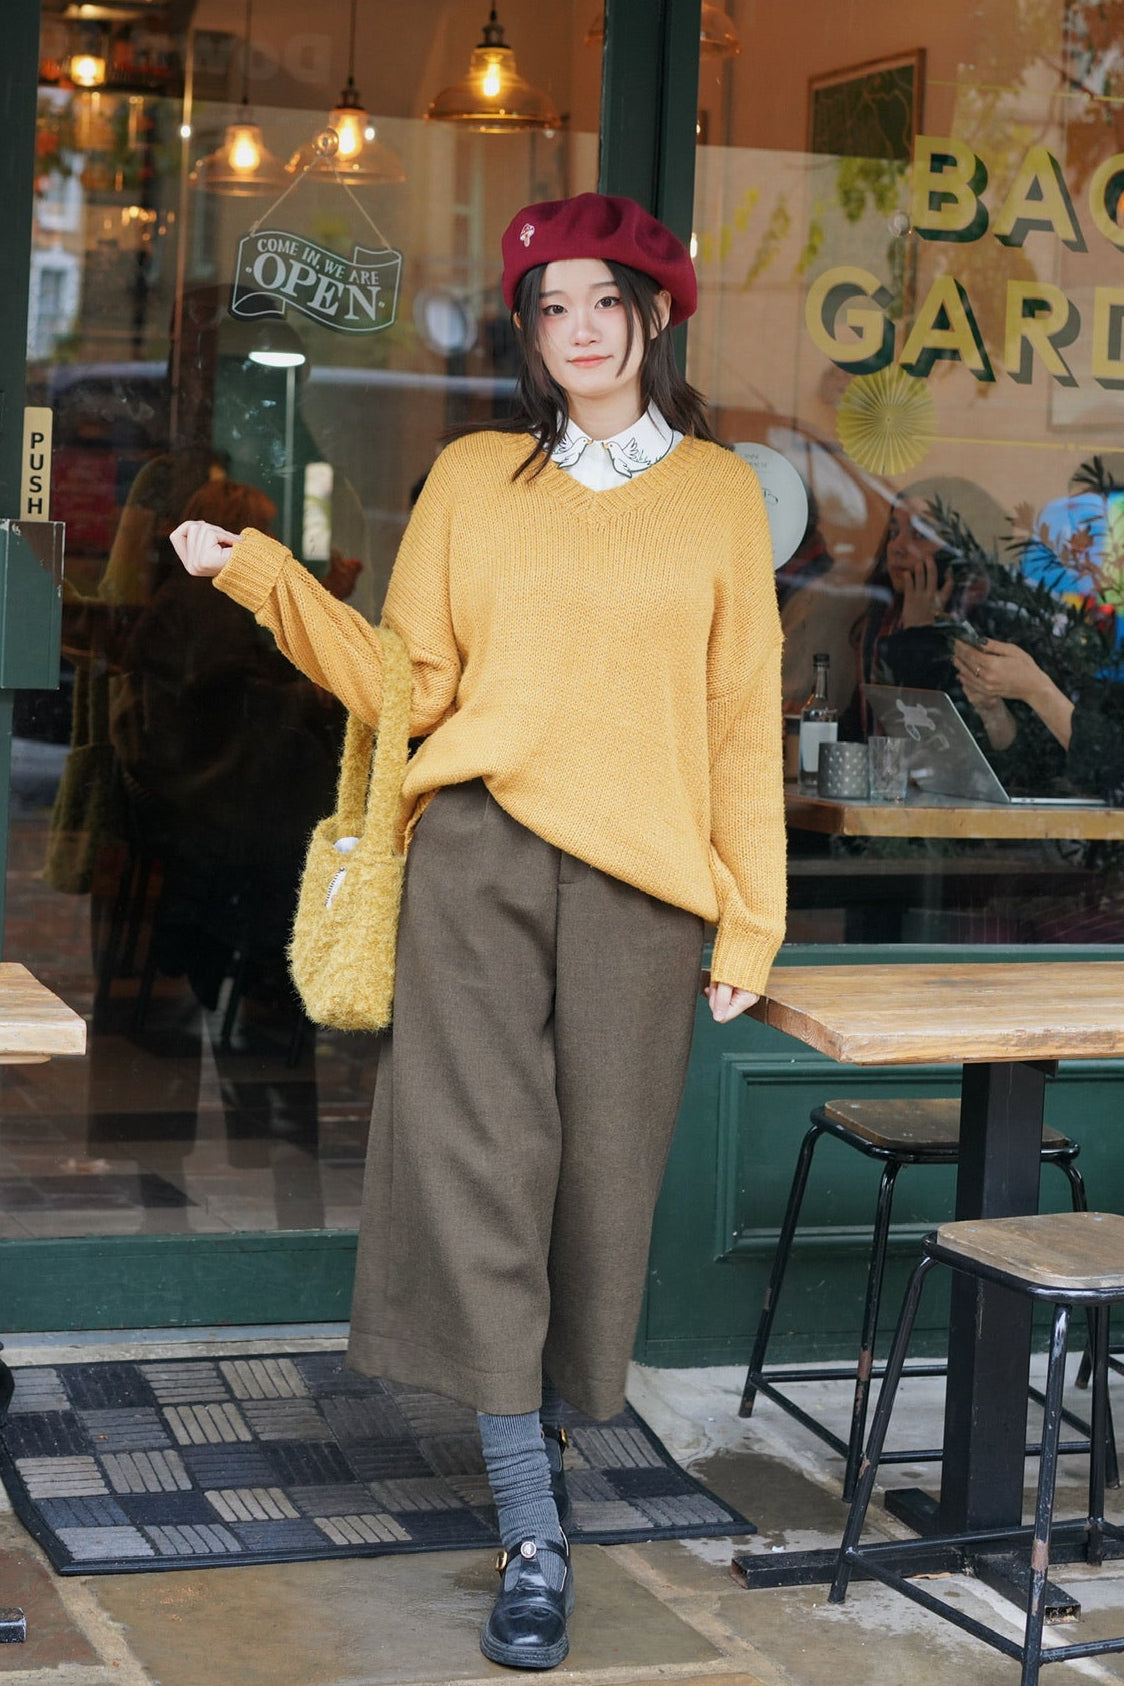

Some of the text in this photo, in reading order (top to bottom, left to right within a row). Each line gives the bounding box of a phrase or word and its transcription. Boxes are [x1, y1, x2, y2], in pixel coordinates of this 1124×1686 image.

[253, 252, 382, 321] OPEN
[257, 238, 299, 256] COME
[325, 259, 345, 279] WE
[349, 270, 379, 285] ARE
[27, 432, 45, 514] PUSH
